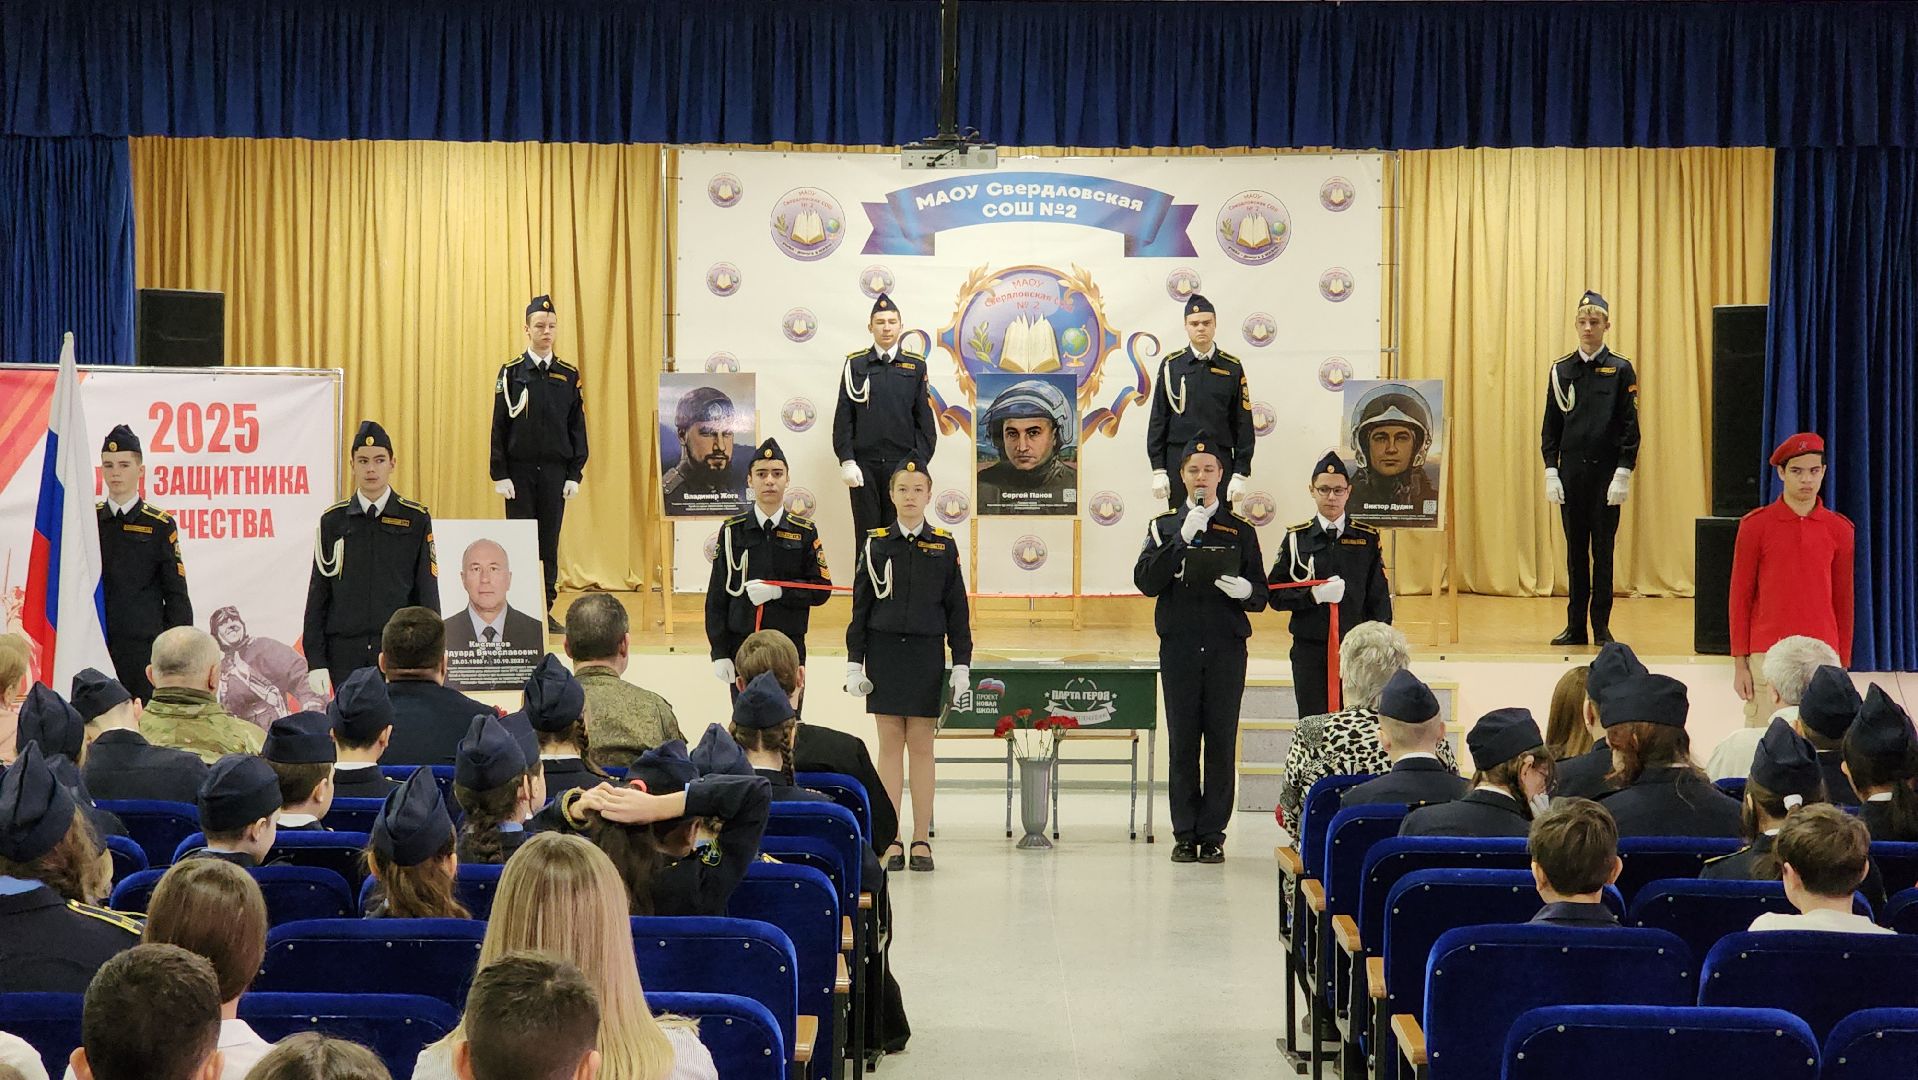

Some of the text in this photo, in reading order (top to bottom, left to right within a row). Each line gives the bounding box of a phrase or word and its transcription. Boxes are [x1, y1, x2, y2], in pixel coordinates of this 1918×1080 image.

[916, 182, 1144, 212] МАОУ Свердловская
[982, 202, 1078, 219] СОШ №2
[1012, 279, 1044, 288] МАОУ
[148, 401, 259, 453] 2025
[153, 465, 310, 500] ЗАЩИТНИКА
[447, 649, 475, 657] дуард
[1051, 690, 1110, 700] ПАРТА ГЕРОЯ
